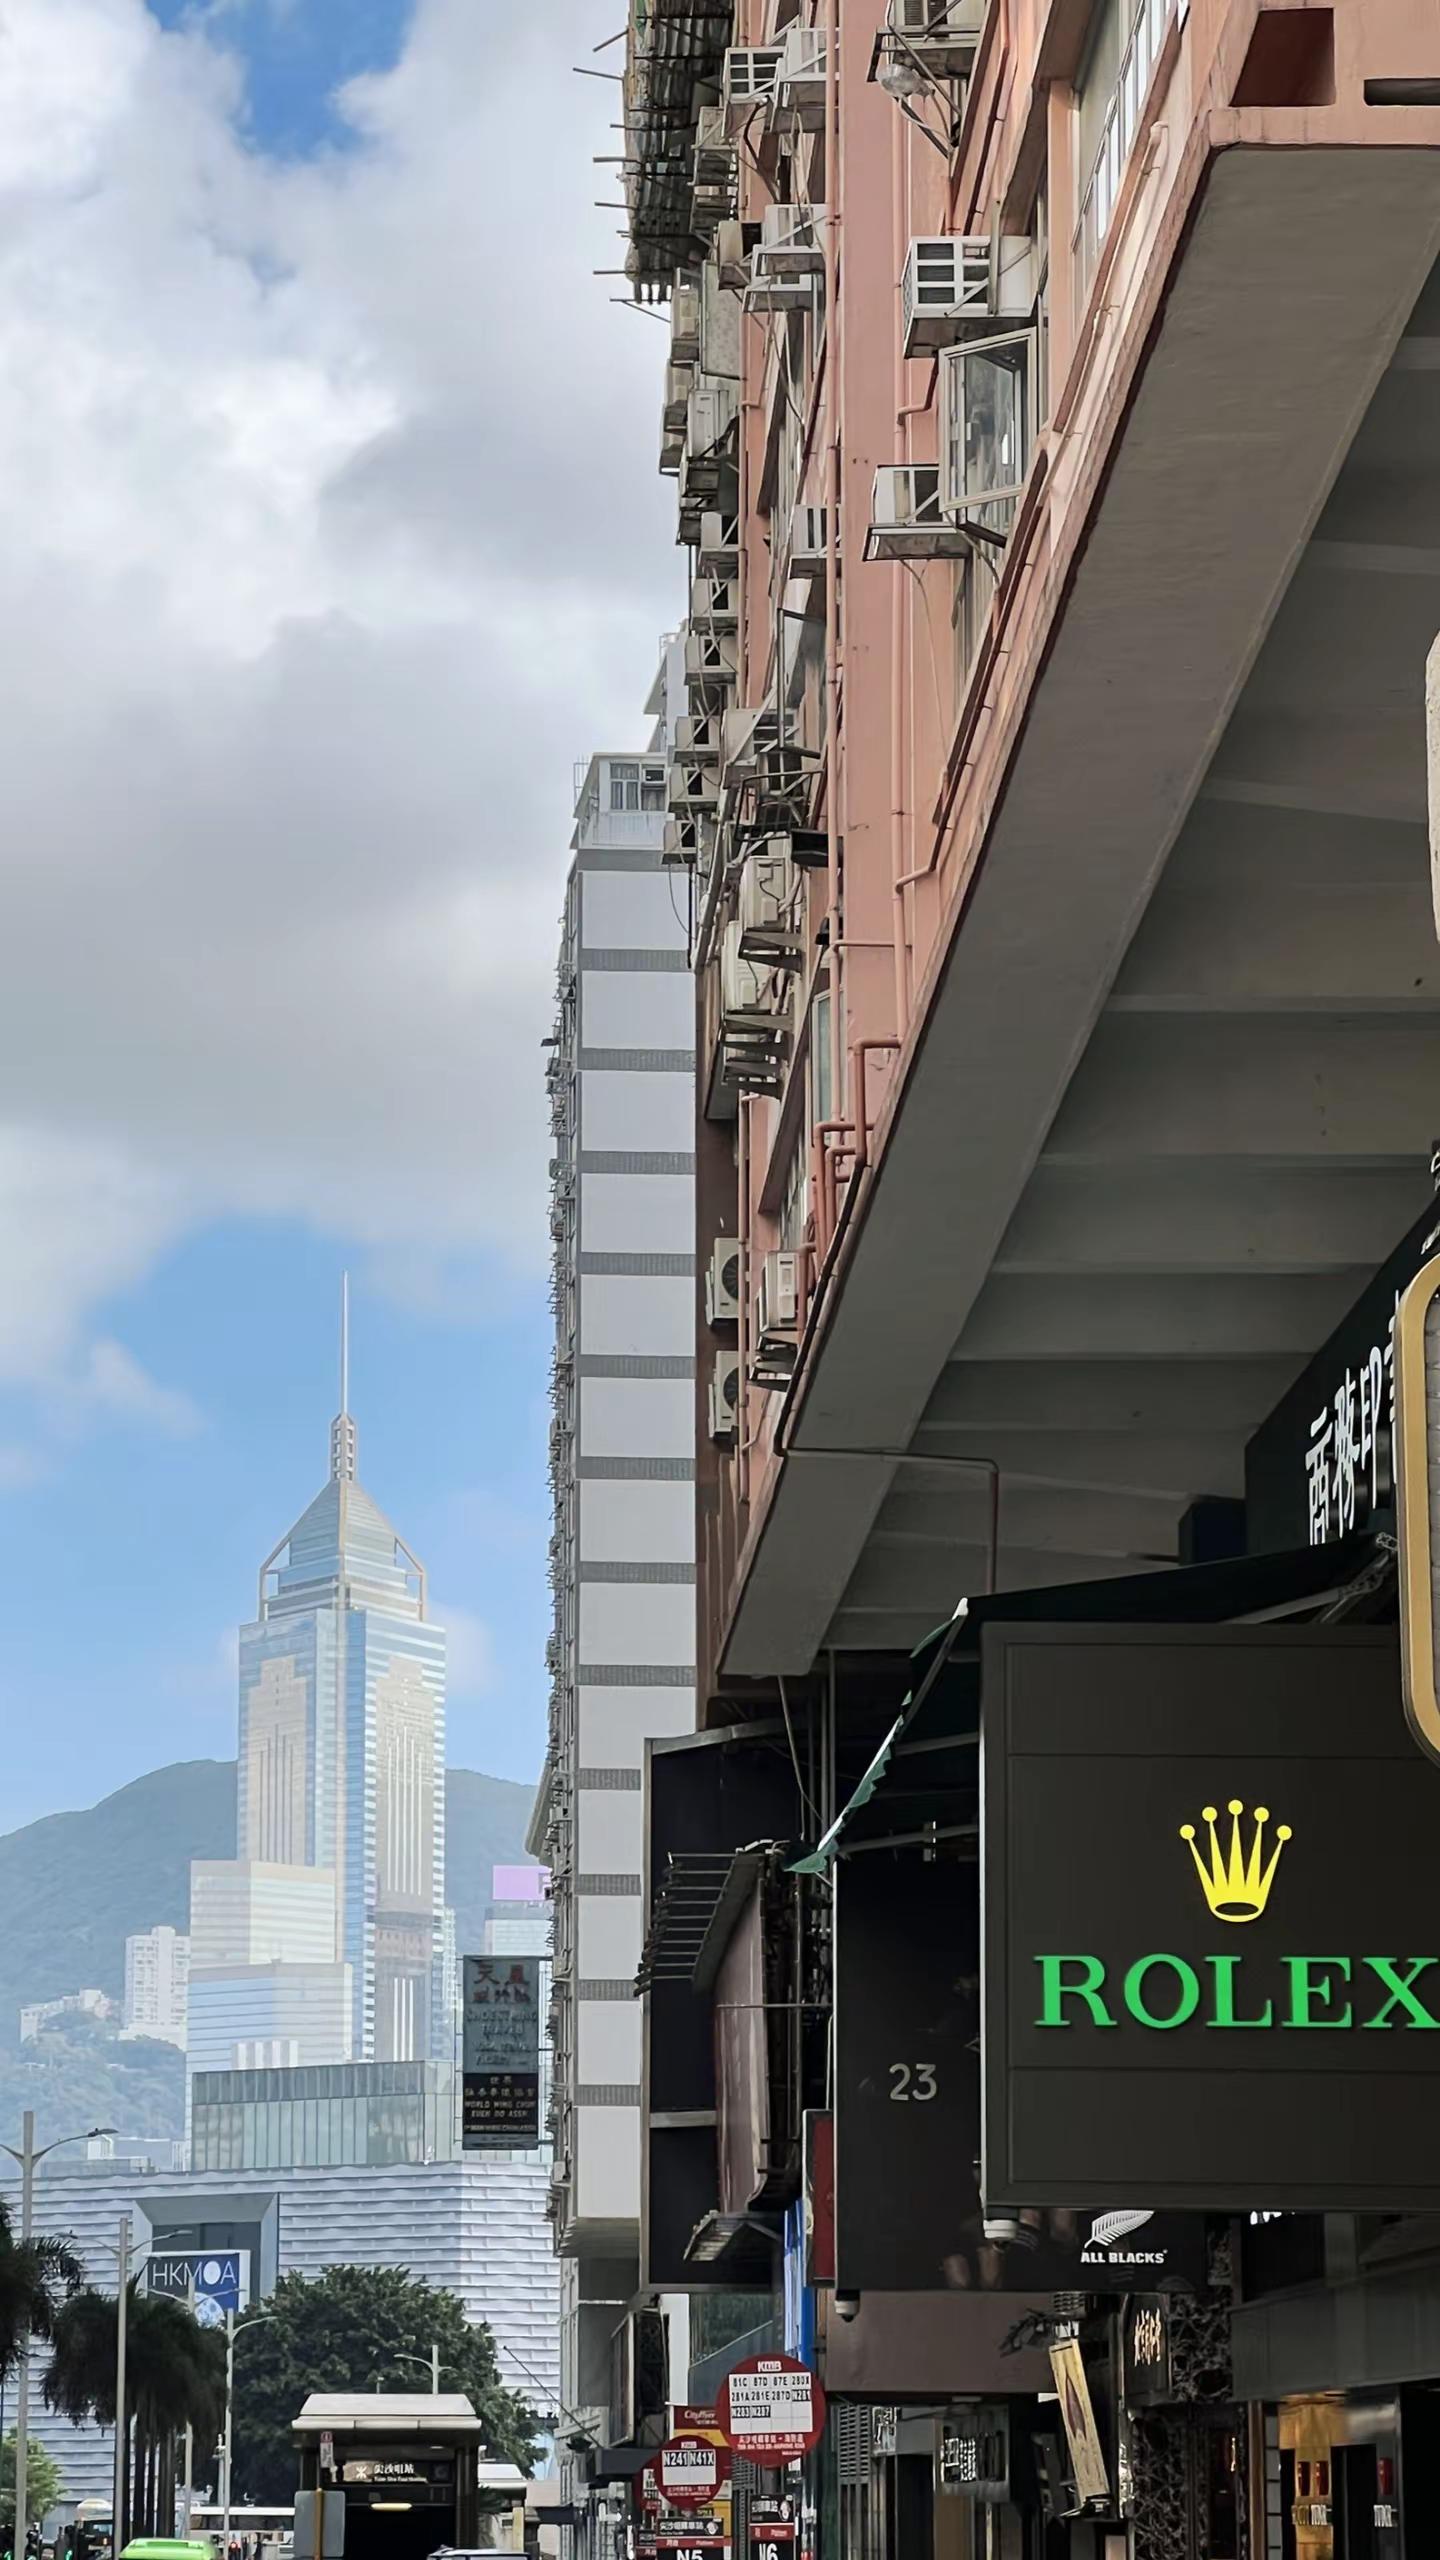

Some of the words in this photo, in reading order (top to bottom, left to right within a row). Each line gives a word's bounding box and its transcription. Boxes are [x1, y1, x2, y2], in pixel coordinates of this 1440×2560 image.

[1033, 1953, 1440, 2030] ROLEX
[889, 2064, 937, 2101] 23
[1080, 2252, 1106, 2264] ALL
[1108, 2252, 1165, 2264] BLACKS
[152, 2261, 237, 2287] HKMOA
[754, 2376, 768, 2387] 87D
[773, 2376, 788, 2386] 87E
[751, 2391, 770, 2401] 281E
[664, 2452, 688, 2466] N241
[689, 2451, 714, 2466] N41X
[676, 2549, 703, 2560] N5
